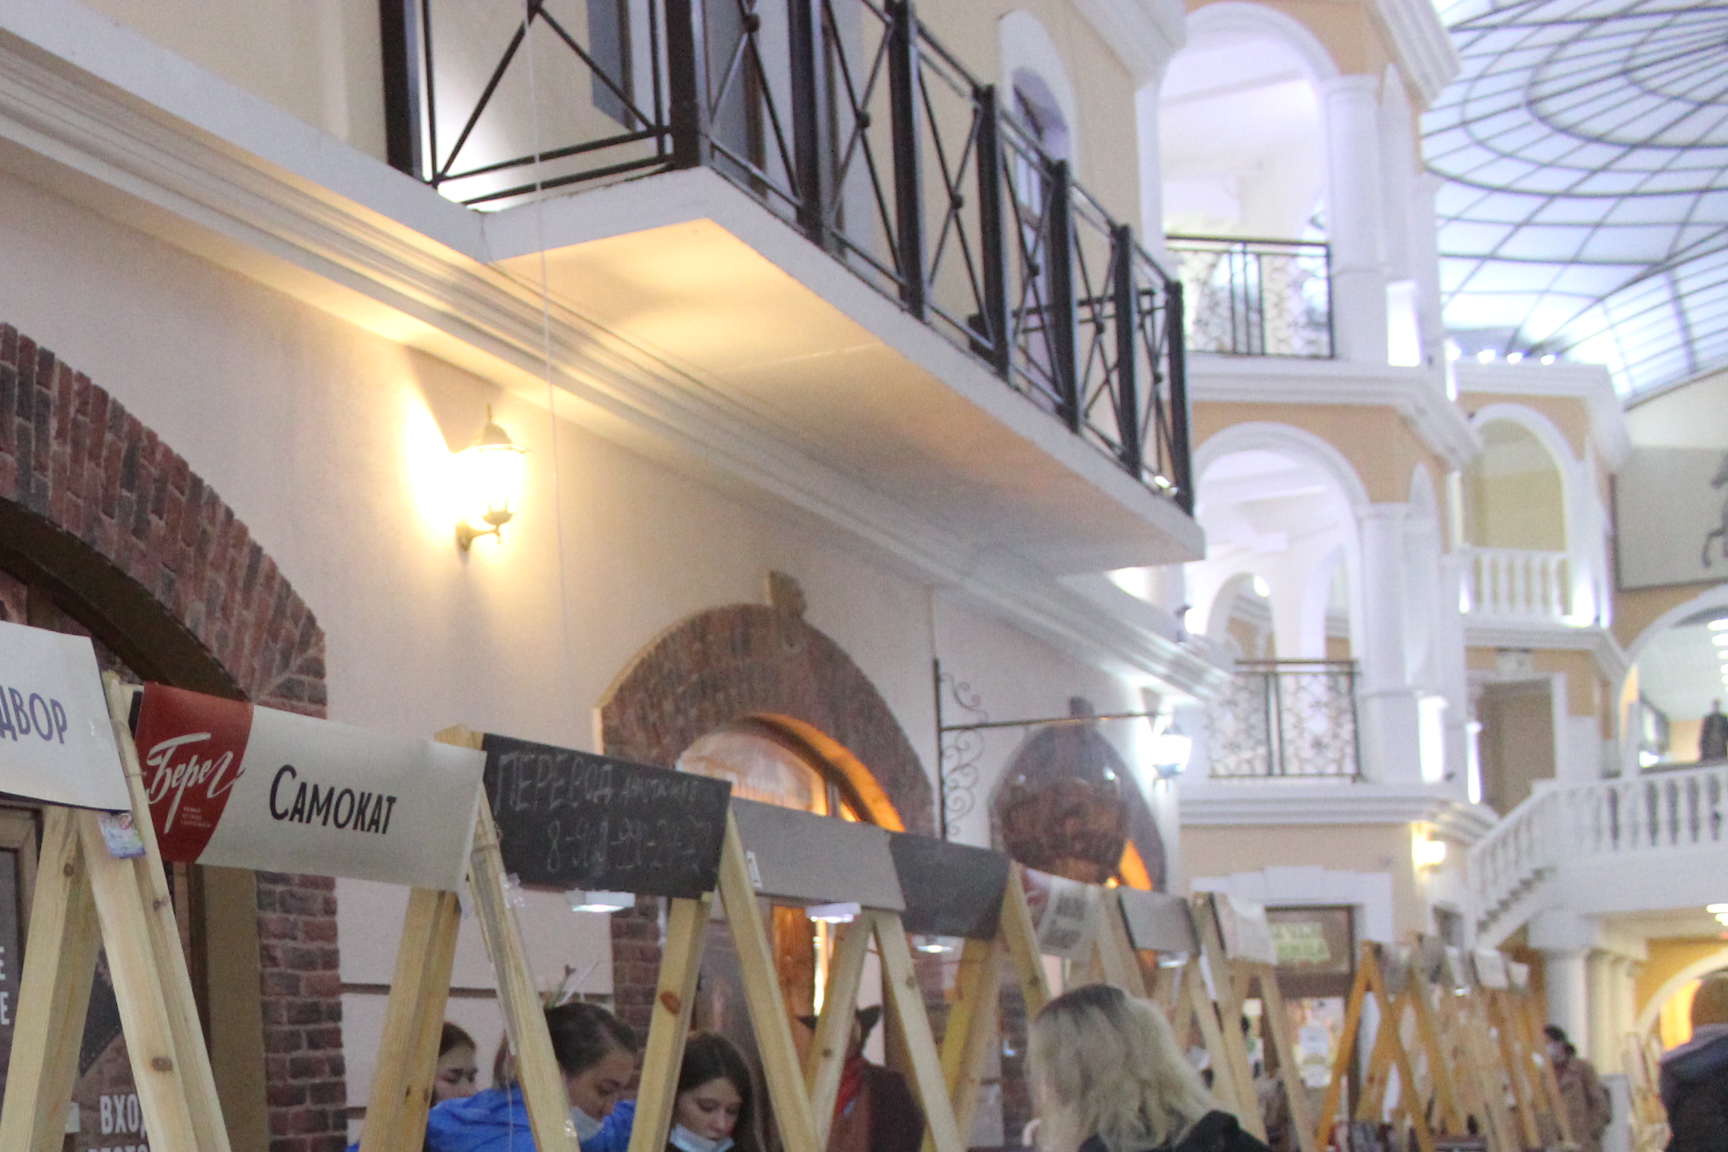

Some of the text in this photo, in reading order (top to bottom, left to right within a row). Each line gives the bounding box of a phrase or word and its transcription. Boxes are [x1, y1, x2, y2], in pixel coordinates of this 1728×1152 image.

[142, 732, 246, 834] Берег
[269, 764, 397, 834] САМОКАТ
[100, 1094, 147, 1139] ВХО
